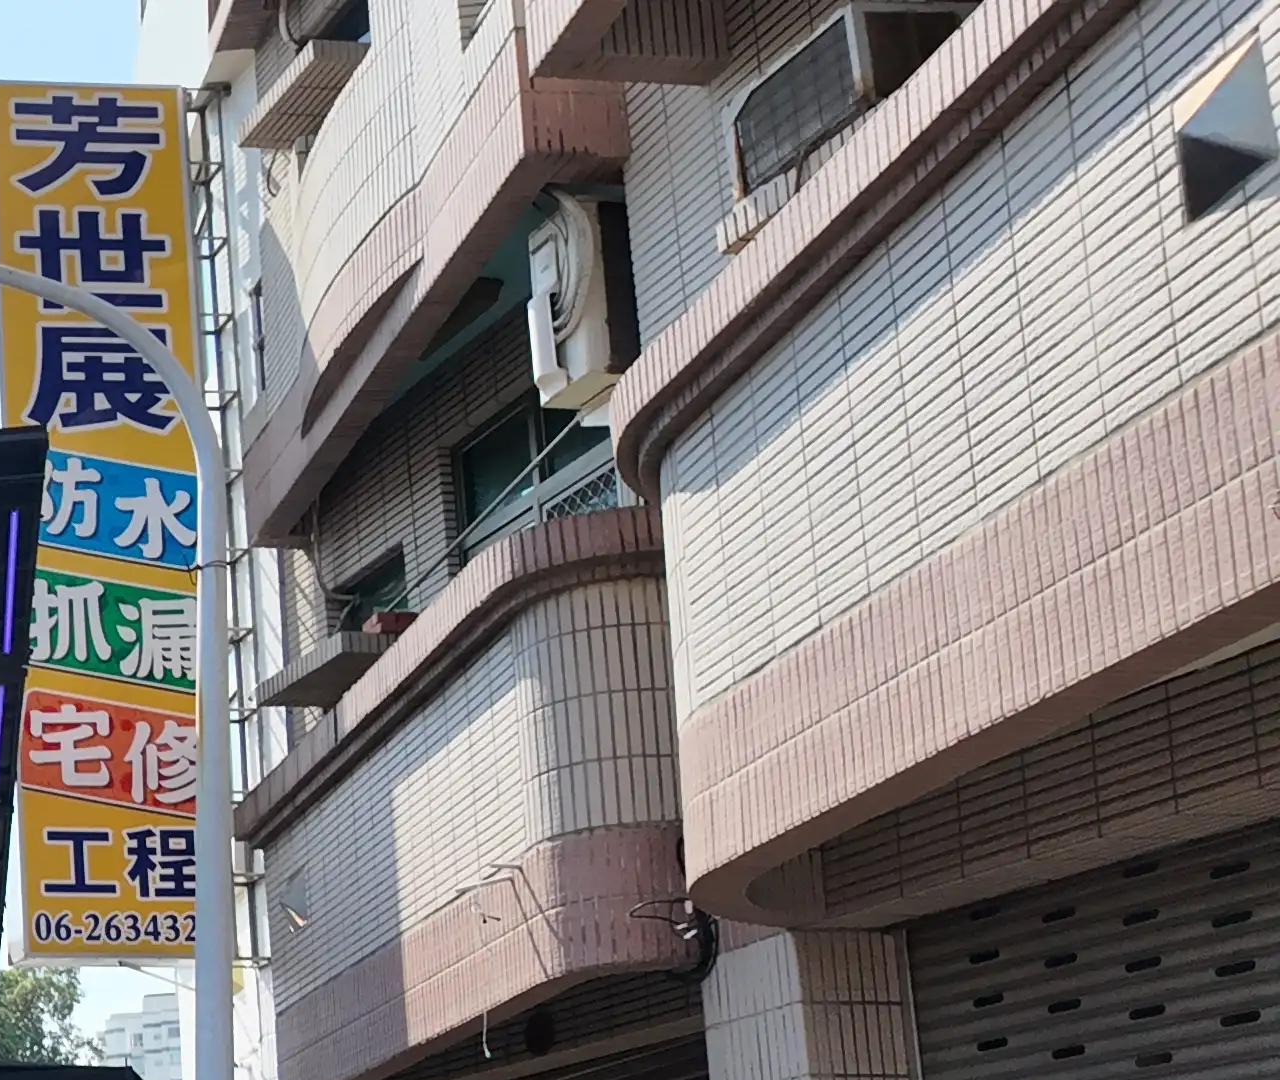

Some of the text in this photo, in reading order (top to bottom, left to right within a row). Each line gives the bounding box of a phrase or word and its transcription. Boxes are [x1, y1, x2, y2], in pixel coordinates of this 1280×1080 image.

[13, 95, 177, 430] 芳世展
[41, 457, 198, 560] 防水
[29, 579, 198, 680] 抓漏
[29, 703, 197, 804] 宅修
[43, 829, 196, 899] 工程
